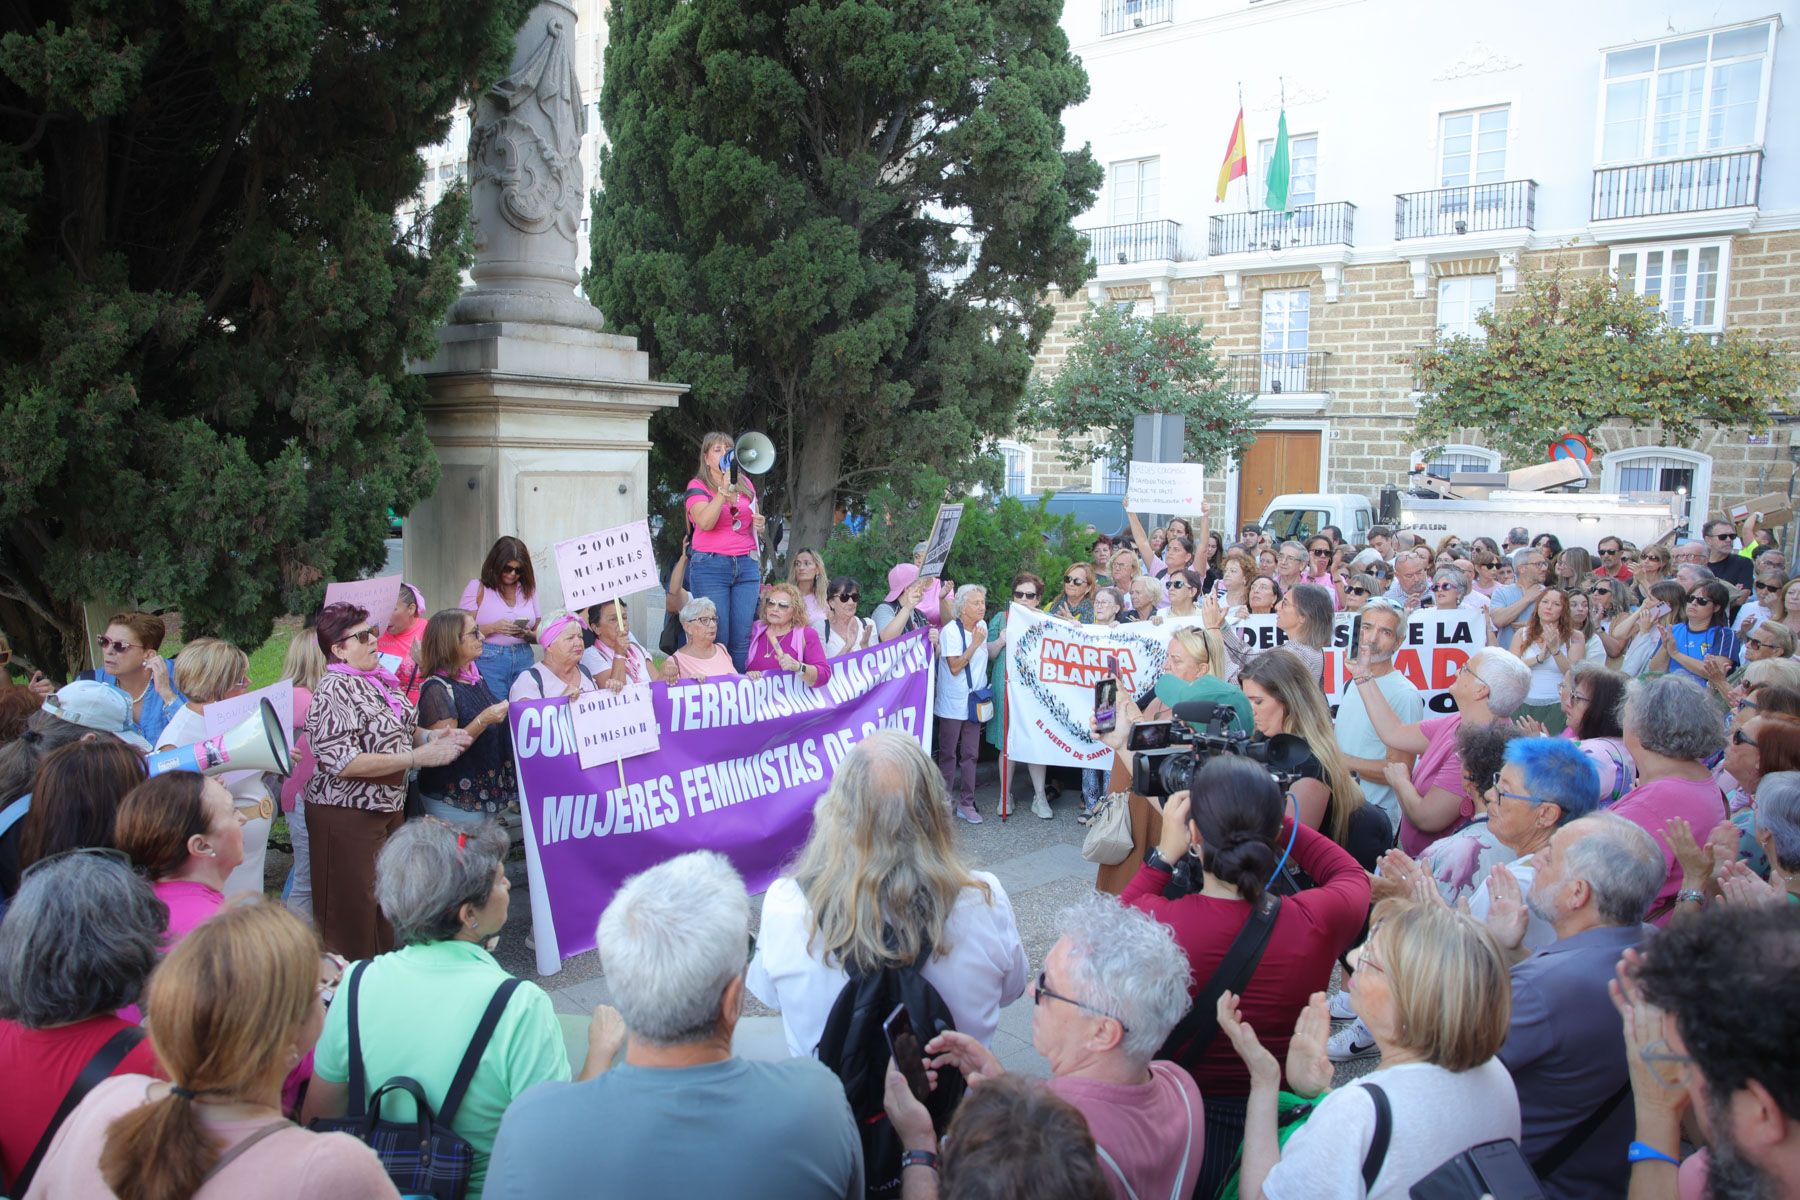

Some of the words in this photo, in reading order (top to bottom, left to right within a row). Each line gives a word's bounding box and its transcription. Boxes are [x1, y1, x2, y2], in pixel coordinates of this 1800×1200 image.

[1412, 523, 1447, 531] FAUN
[577, 532, 629, 556] 2000
[574, 550, 643, 578] MUJERES
[572, 569, 648, 598] OLVIDADAS
[1436, 622, 1473, 643] LA
[667, 674, 827, 732] TERRORISMO
[829, 633, 929, 704] MACHISTA
[1040, 660, 1136, 693] BLANA
[1035, 719, 1045, 730] EL
[1043, 728, 1073, 753] PUERTO
[1072, 750, 1084, 761] DE
[1086, 746, 1112, 761] SANTA
[542, 775, 680, 847] MUJERES
[680, 738, 823, 818] FEMINISTAS
